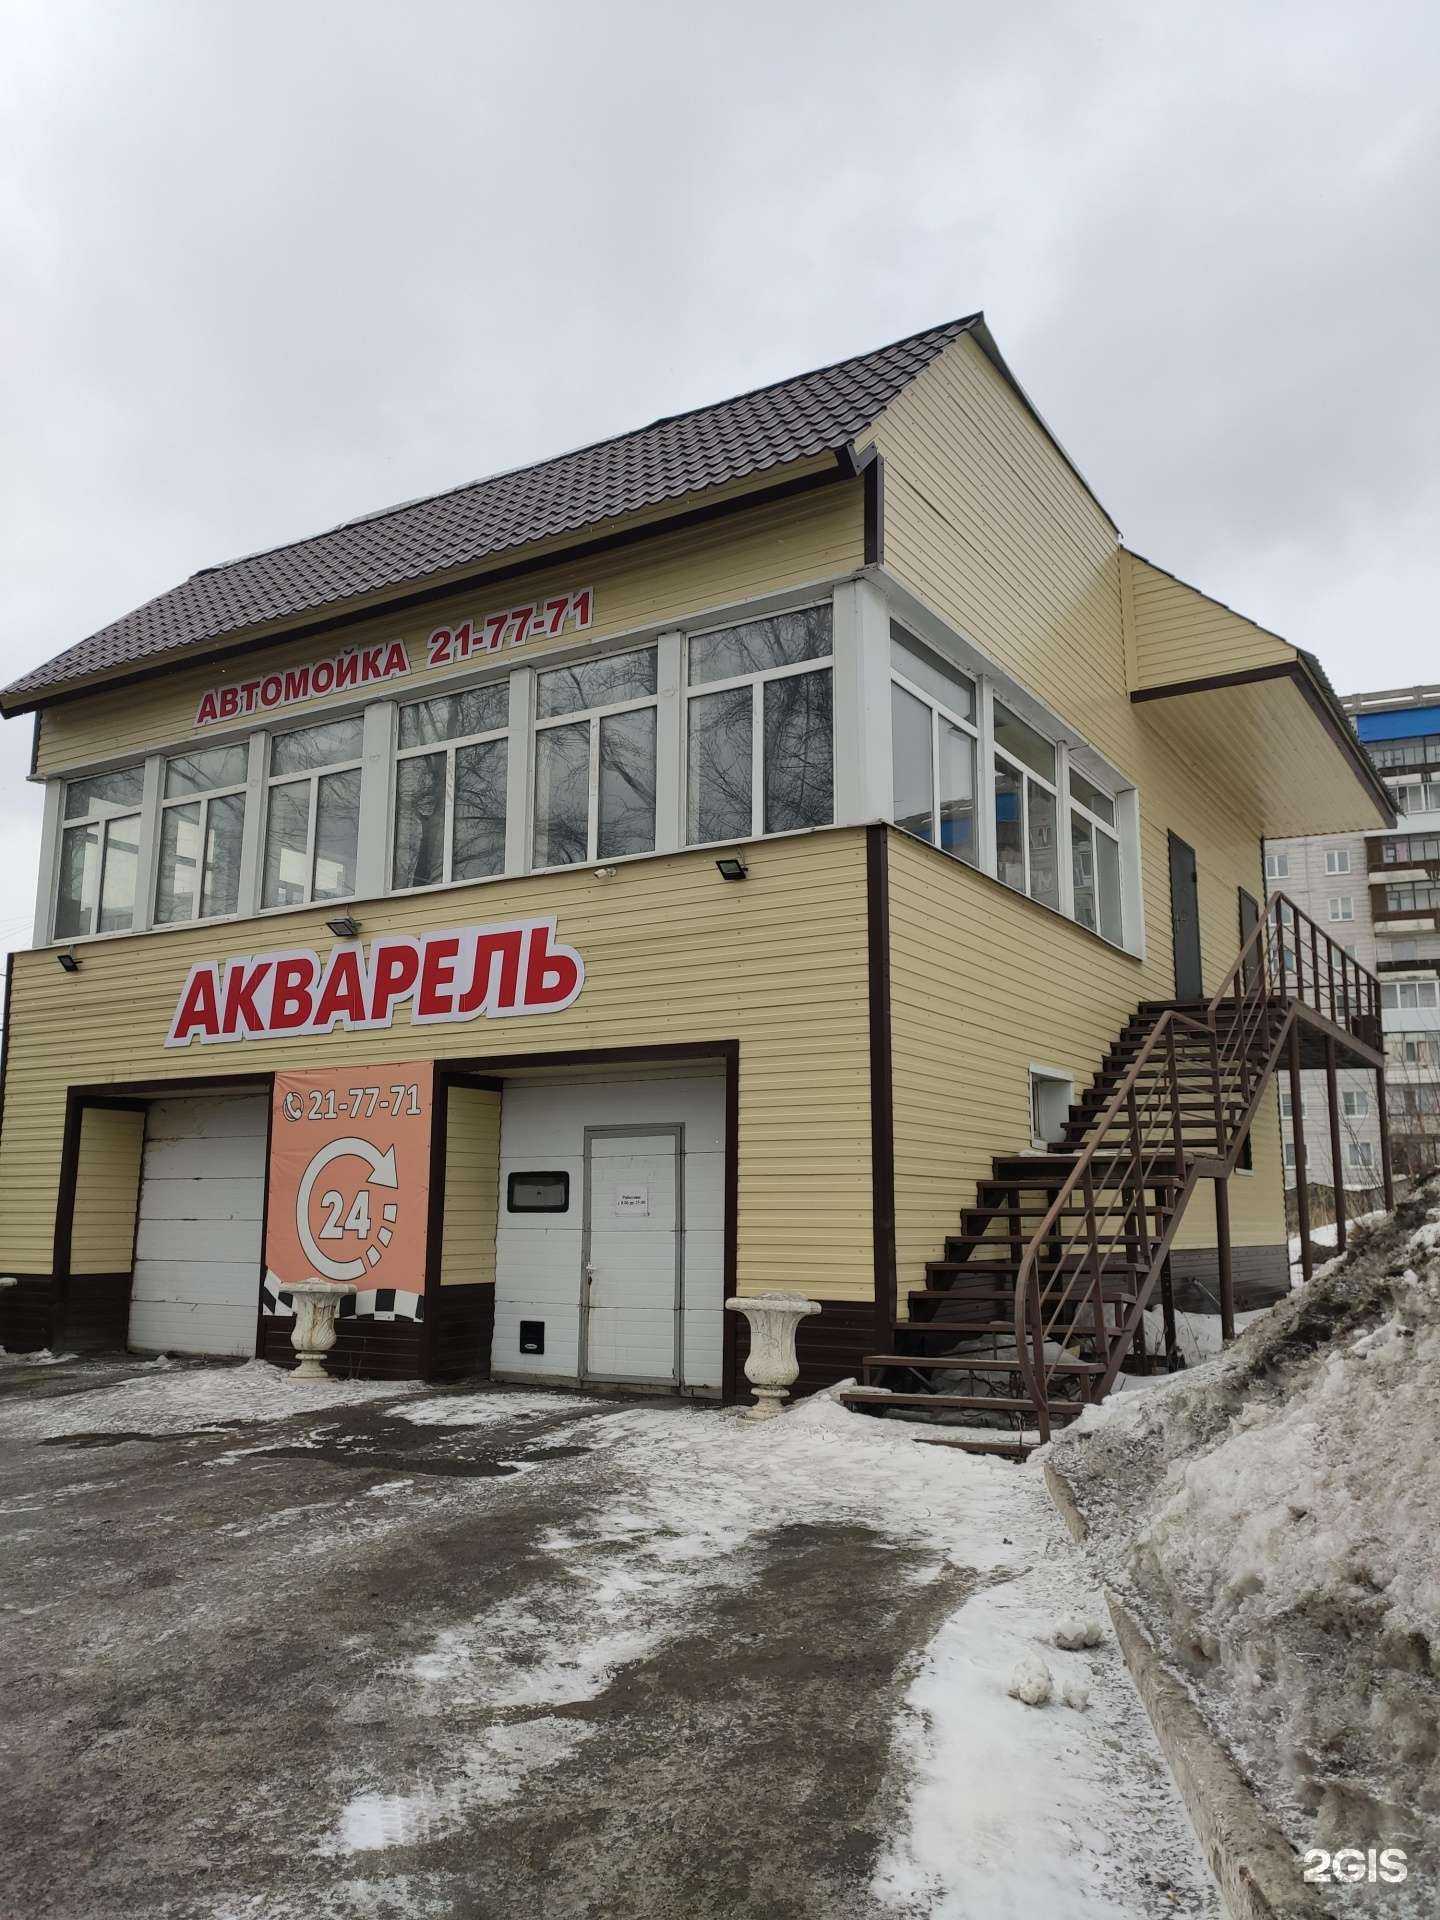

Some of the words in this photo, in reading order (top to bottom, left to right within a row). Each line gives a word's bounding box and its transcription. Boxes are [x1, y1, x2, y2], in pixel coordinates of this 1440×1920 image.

[197, 642, 410, 724] АВТОМОЙКА
[429, 591, 591, 665] 21-77-71
[173, 926, 579, 1039] АКВАРЕЛЬ
[307, 1083, 421, 1120] 21-77-71
[317, 1189, 372, 1240] 24
